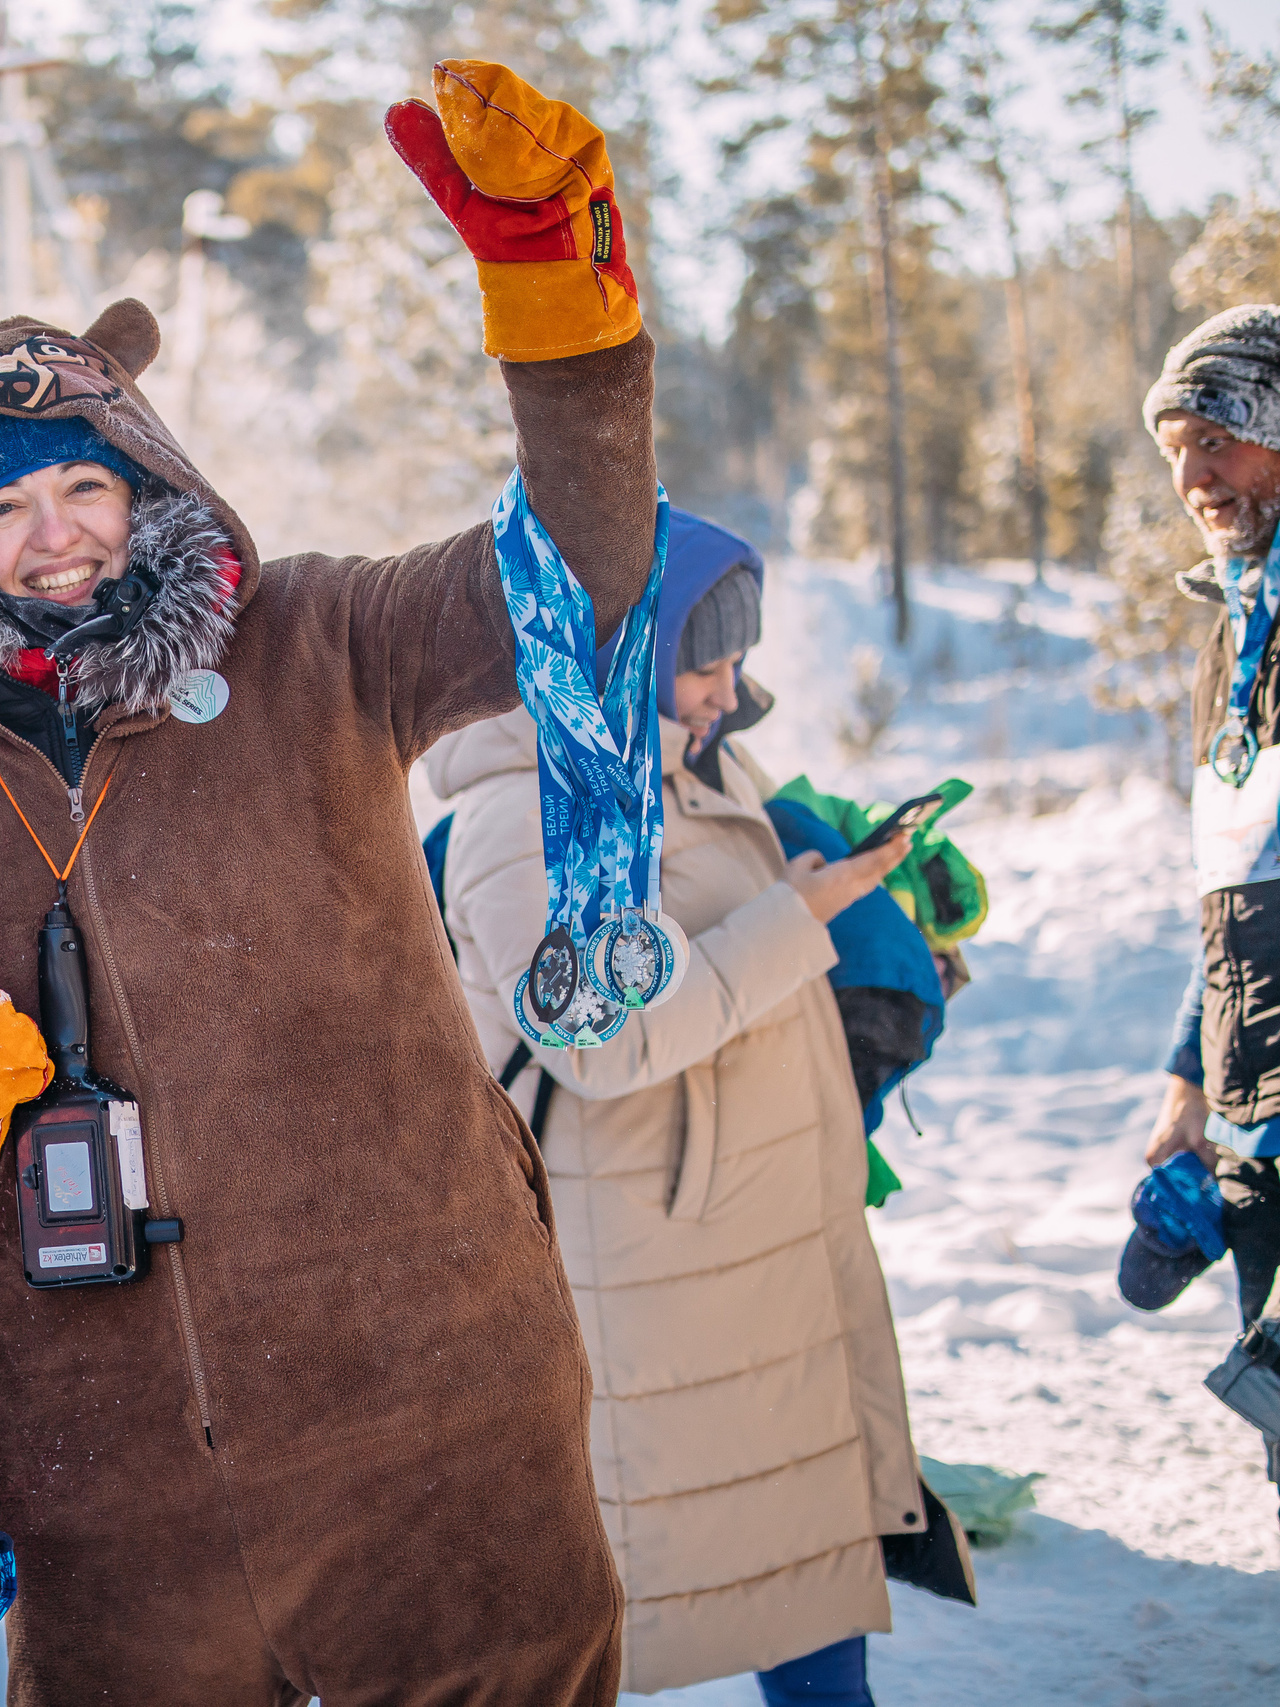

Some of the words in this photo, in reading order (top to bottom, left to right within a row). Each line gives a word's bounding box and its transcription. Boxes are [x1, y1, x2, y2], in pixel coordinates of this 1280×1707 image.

[594, 206, 602, 226] 100%
[602, 203, 610, 228] POWER
[181, 698, 202, 716] SERIES
[578, 757, 602, 797] БЕЛЫЙ
[590, 756, 610, 794] ТРЕЙЛ
[542, 794, 557, 836] БЕЛЫЙ
[556, 796, 570, 834] ТРЕЙЛ
[599, 924, 614, 937] 2023
[588, 937, 600, 960] SERIES
[588, 962, 596, 982] TRAIL
[516, 976, 528, 998] SERIES
[596, 982, 612, 998] TAIGA
[522, 1021, 536, 1038] TAIGA
[554, 1025, 571, 1041] TAIGA
[42, 1252, 88, 1264] Athletex.kz
